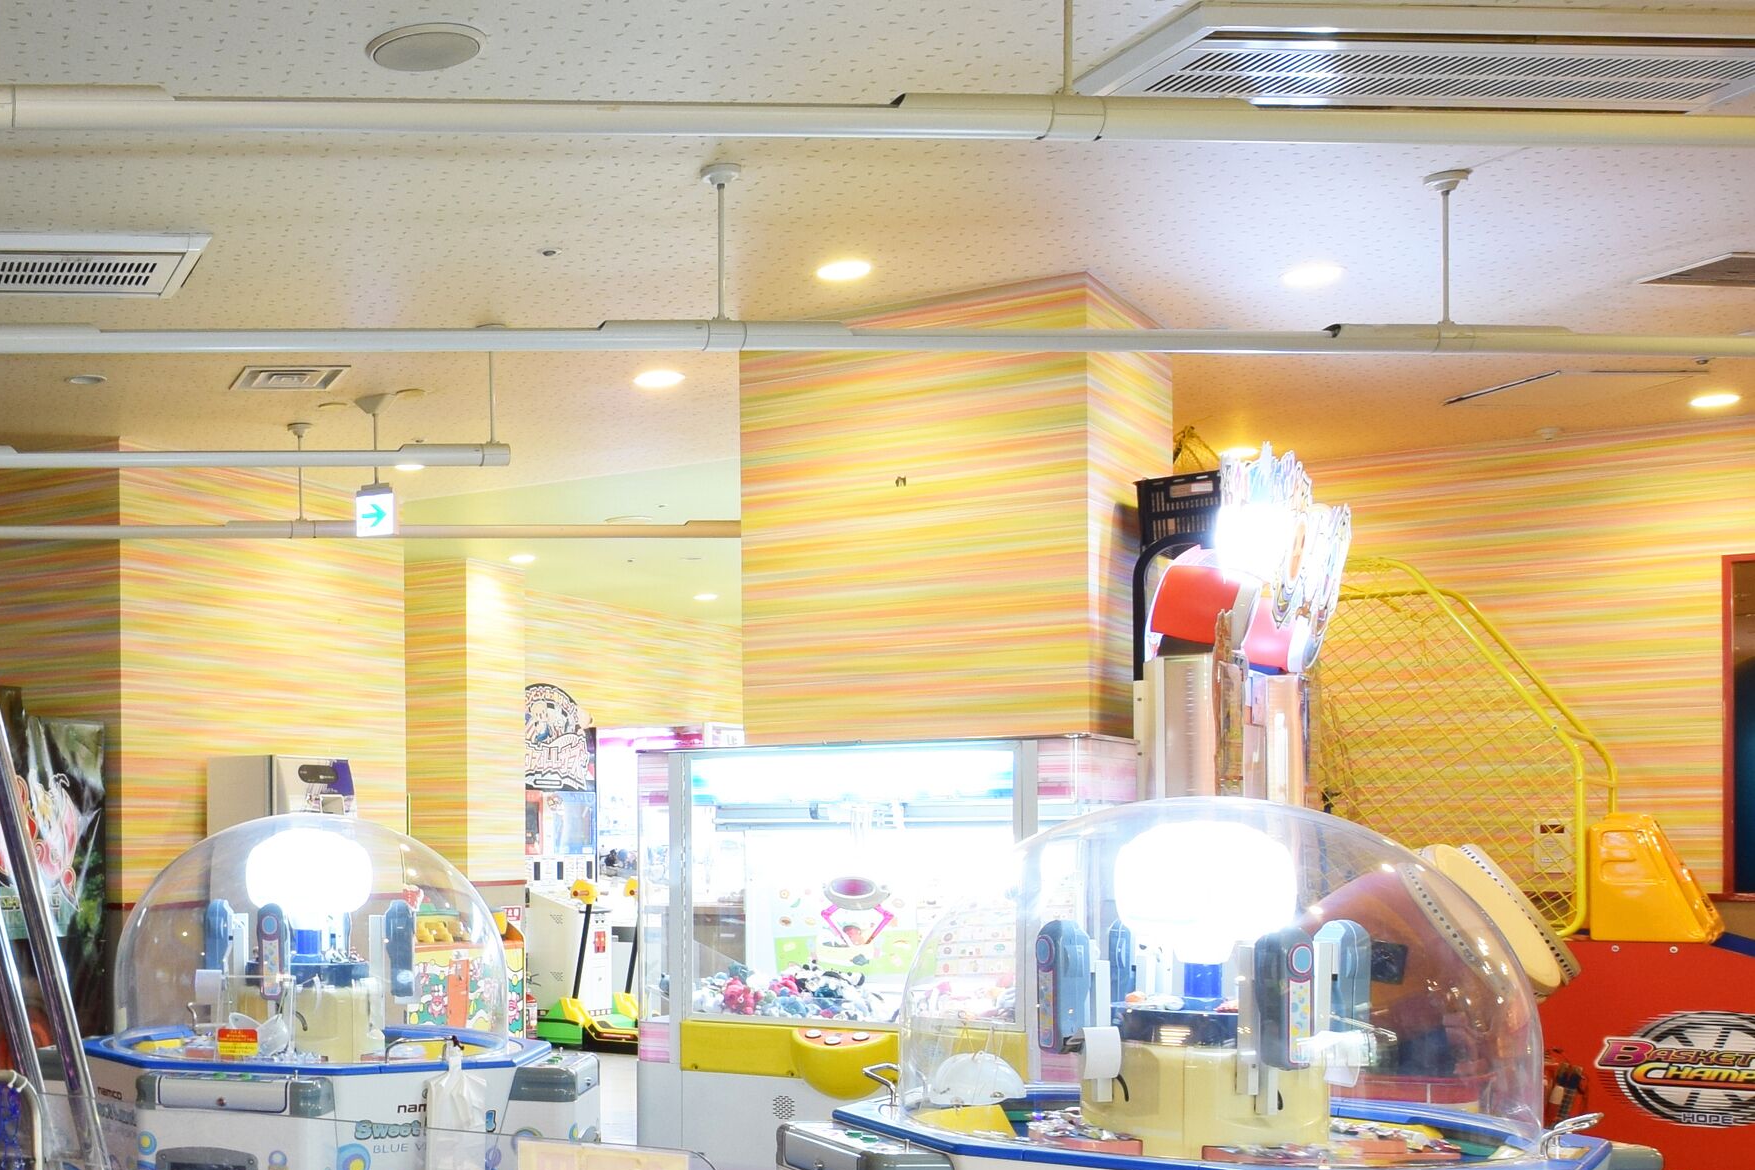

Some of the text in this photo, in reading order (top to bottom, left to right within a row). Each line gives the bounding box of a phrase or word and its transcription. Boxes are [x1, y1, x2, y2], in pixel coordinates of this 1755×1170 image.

[1682, 1113, 1733, 1124] HOPE
[354, 1119, 422, 1141] Sweet
[372, 1142, 408, 1154] BLUE
